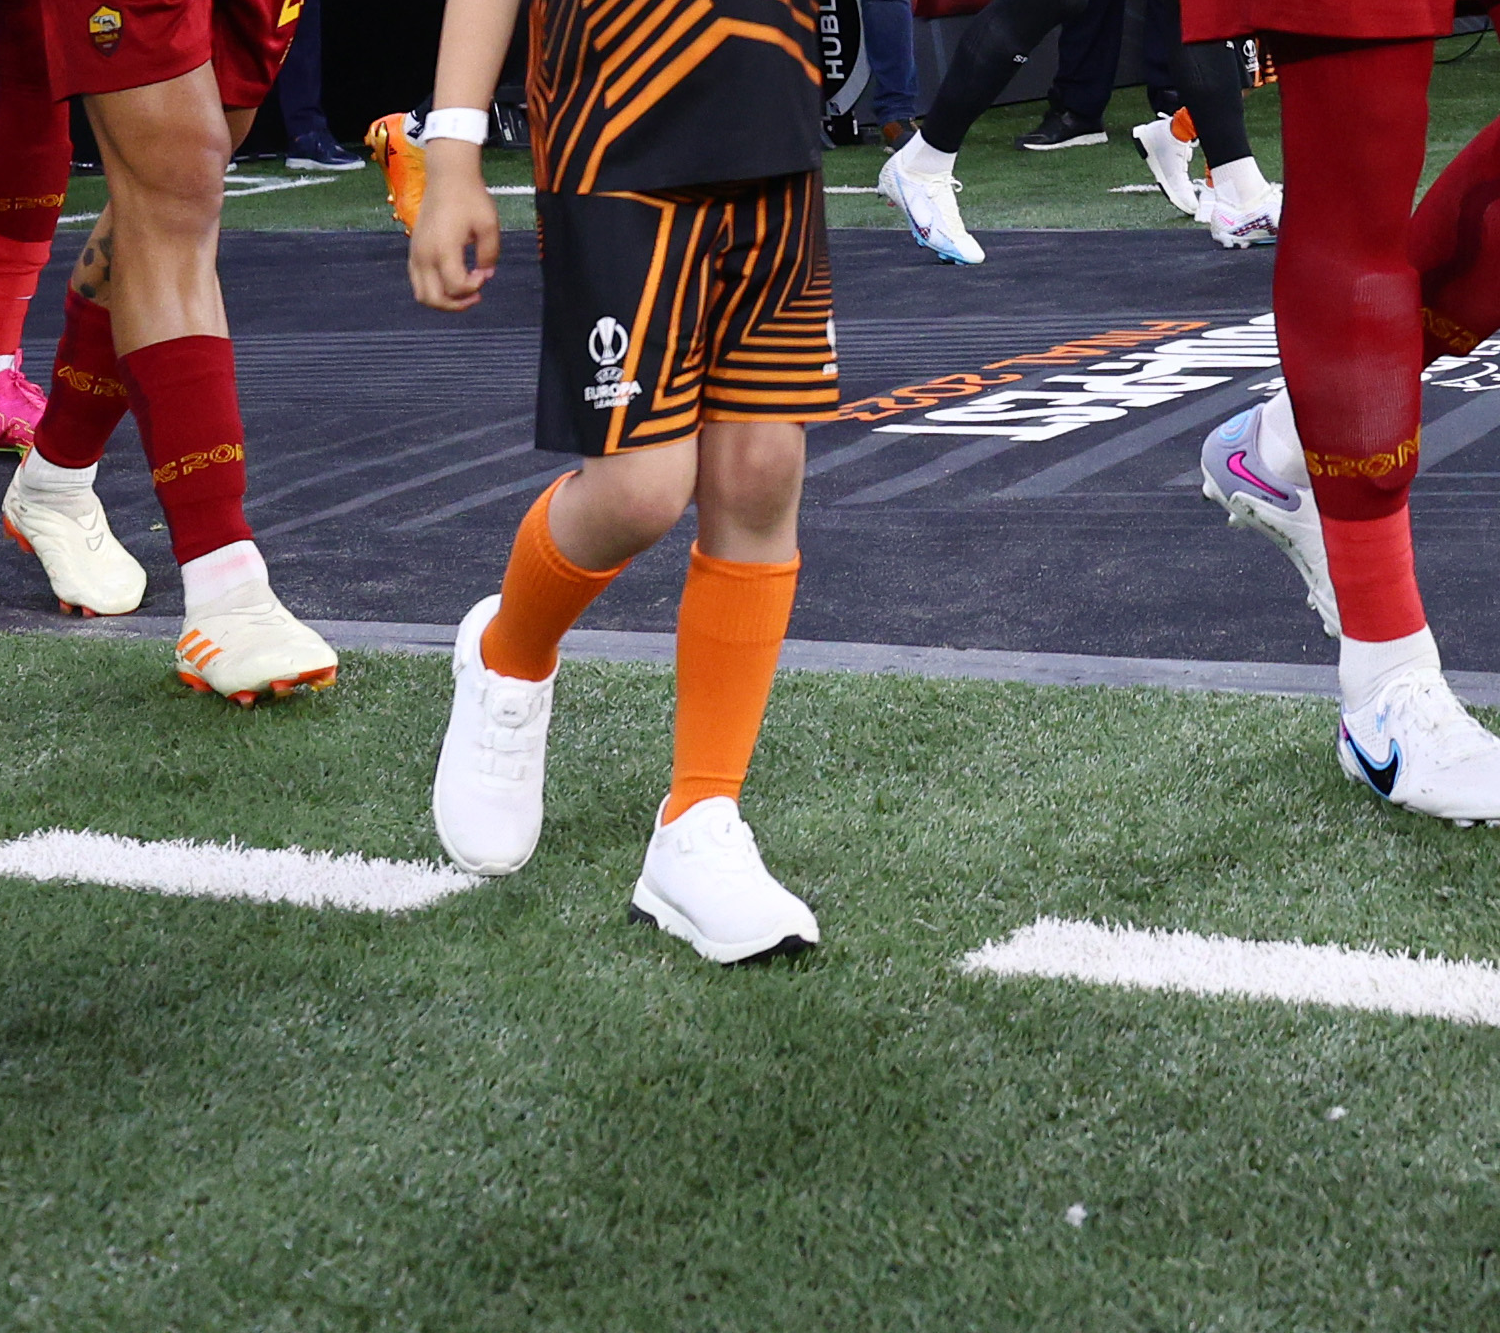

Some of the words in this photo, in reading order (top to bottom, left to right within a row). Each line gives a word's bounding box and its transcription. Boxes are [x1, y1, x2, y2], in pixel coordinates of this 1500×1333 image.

[15, 192, 66, 211] RO
[981, 319, 1212, 371] FINAL
[584, 381, 643, 403] EUROPA
[593, 395, 632, 411] LEAGUE
[836, 372, 1024, 423] 2023
[179, 443, 246, 476] RO
[1325, 437, 1419, 478] ROM
